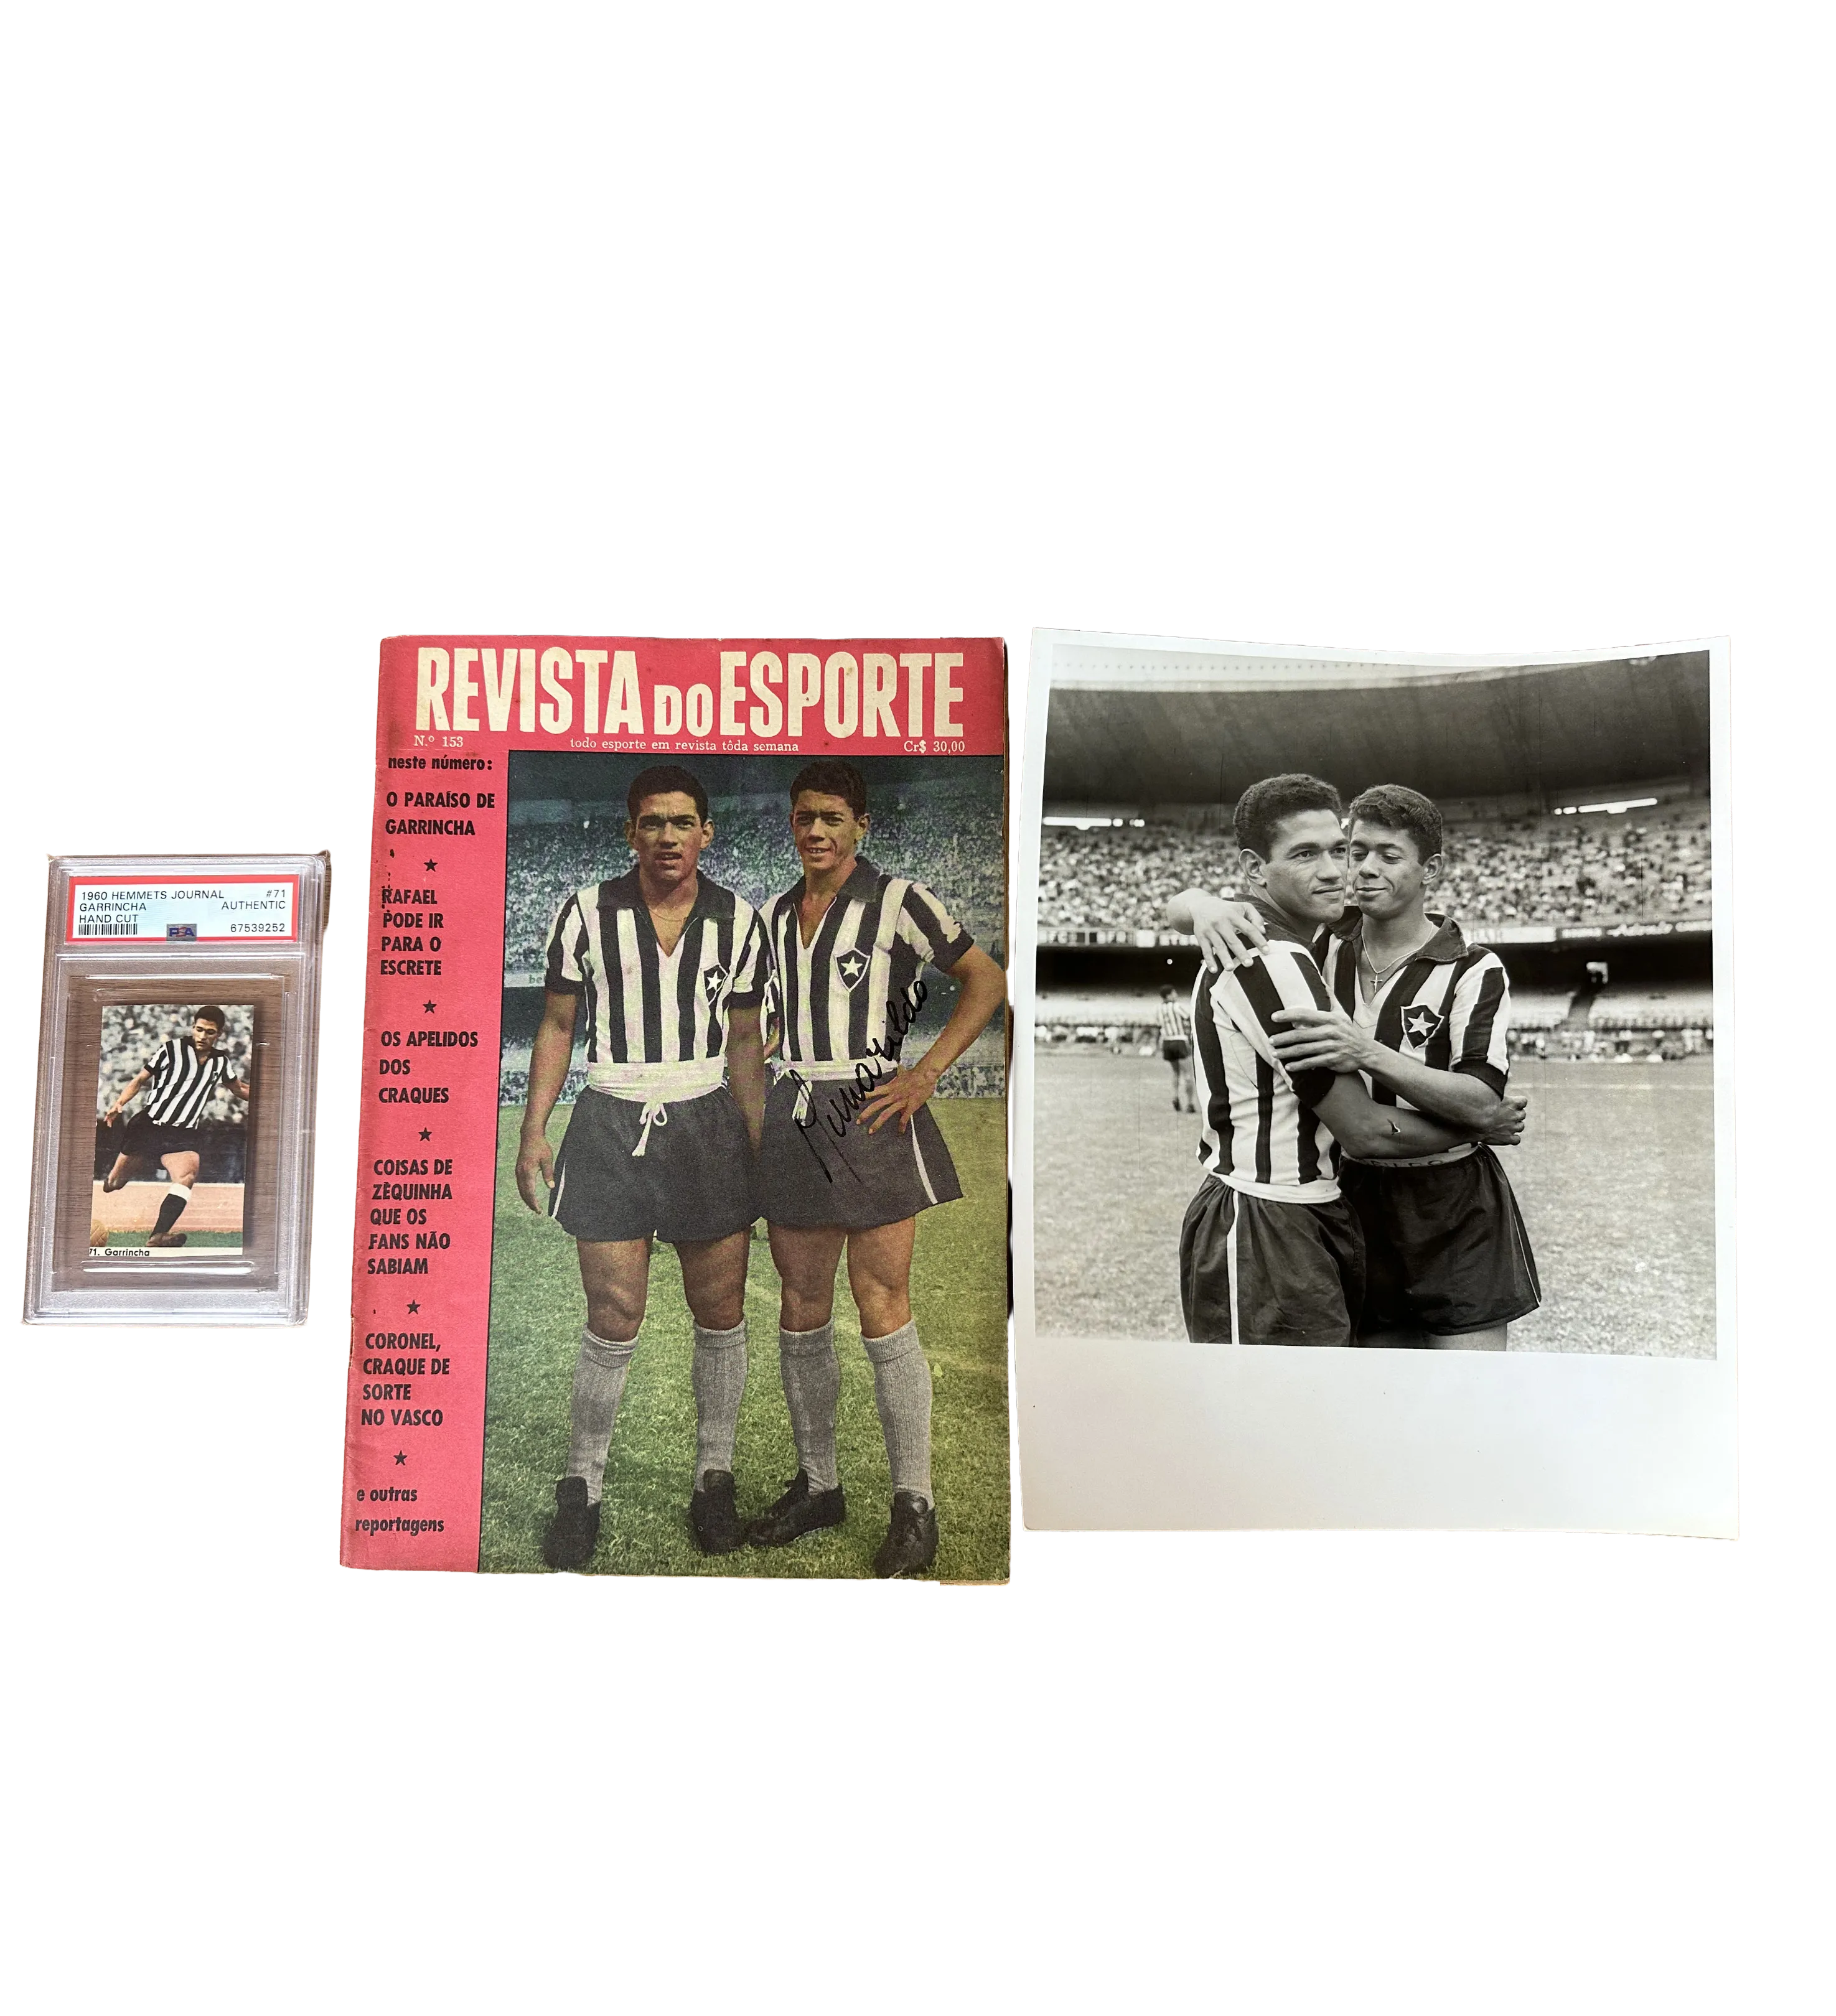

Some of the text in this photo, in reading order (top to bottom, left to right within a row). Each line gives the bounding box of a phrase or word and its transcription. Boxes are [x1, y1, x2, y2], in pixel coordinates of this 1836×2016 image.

[416, 646, 963, 738] REVISTA DO ESPORTE
[443, 736, 464, 748] 153
[571, 738, 799, 752] todo esporte em revista tôda semana
[904, 740, 965, 754] Cr$ 30,00
[388, 755, 492, 770] neste número:
[386, 791, 495, 808] O PARAÍSO DE
[385, 819, 475, 835] GARRINCHA
[82, 890, 225, 900] 1960 HEMMETS JOURNAL
[266, 889, 286, 898] #71
[382, 889, 438, 904] RAFAEL
[80, 903, 147, 912] GARRINCHA
[222, 900, 286, 910] AUTHENTIC
[79, 914, 139, 923] HAND CUT
[383, 912, 444, 928] PODE IR
[169, 926, 196, 938] PSA
[230, 923, 286, 933] 67539252
[382, 936, 441, 952] PARA O
[380, 959, 442, 975] ESCRETE
[381, 1030, 478, 1047] OS APELIDOS
[380, 1059, 410, 1075] DOS
[378, 1087, 449, 1104] CRAQUES
[373, 1159, 452, 1175] COISAS DE
[370, 1208, 426, 1226] QUE OS
[368, 1231, 451, 1249] FANS NÃO
[105, 1248, 150, 1256] Garrincha
[367, 1258, 428, 1274] SABIAM
[365, 1333, 441, 1351] CORONEL,
[363, 1358, 450, 1376] CRAQUE DE
[363, 1384, 411, 1400] SORTE
[361, 1409, 443, 1426] NO VASCO
[357, 1486, 418, 1501] e outras
[355, 1517, 444, 1536] reportagens
